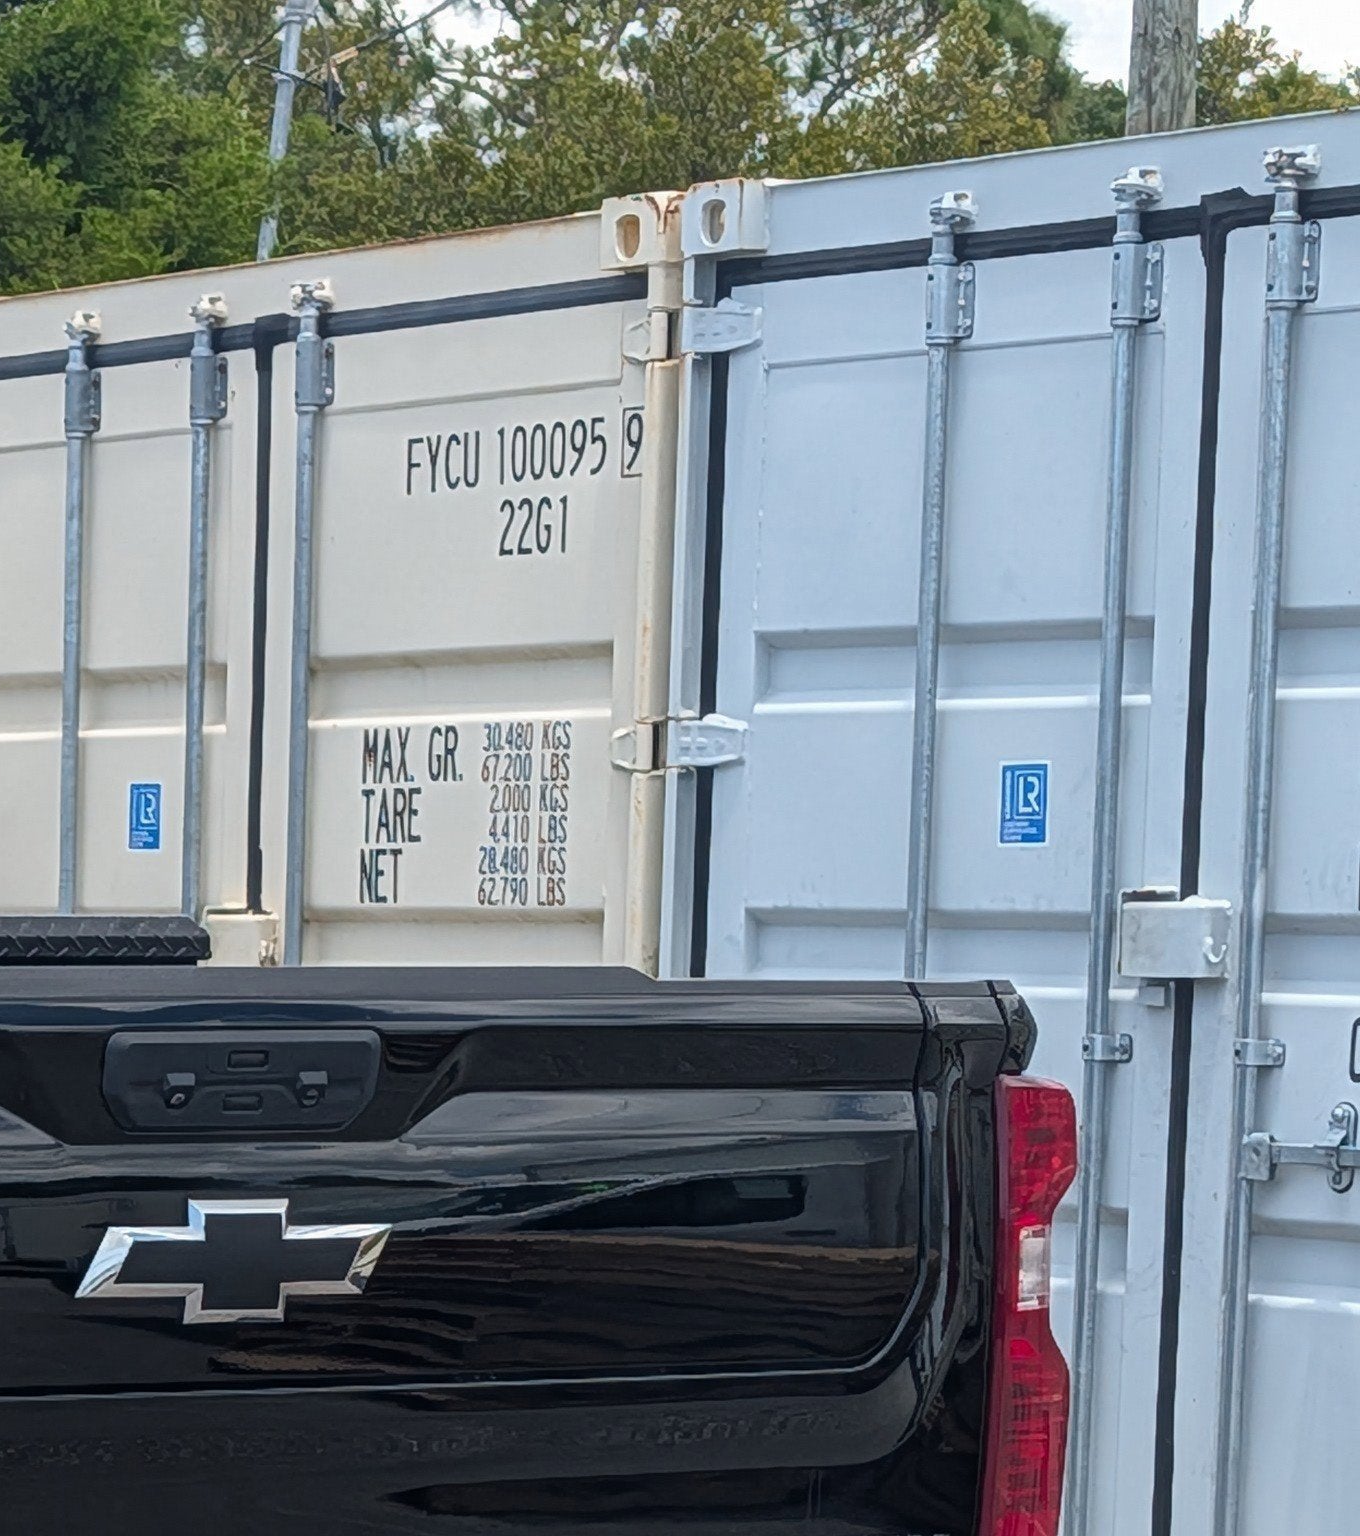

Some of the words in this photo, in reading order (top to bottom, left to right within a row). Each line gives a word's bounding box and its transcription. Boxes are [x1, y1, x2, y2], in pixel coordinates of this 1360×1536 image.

[406, 431, 480, 495] FYCU
[498, 417, 607, 485] 100095
[626, 413, 644, 471] 9
[499, 495, 568, 556] 22G1
[362, 727, 415, 784] MAX.
[428, 725, 463, 782] GR.
[482, 722, 533, 751] 30.480
[541, 720, 571, 751] KGS
[540, 752, 570, 782] LBS
[361, 787, 422, 843] TARE
[489, 784, 531, 813] 2.000
[538, 784, 569, 813] KGS
[538, 815, 568, 843] LBS
[359, 848, 402, 903] NET
[478, 846, 529, 875] 28.480
[537, 846, 567, 875] KGS
[537, 877, 566, 906] LBS
